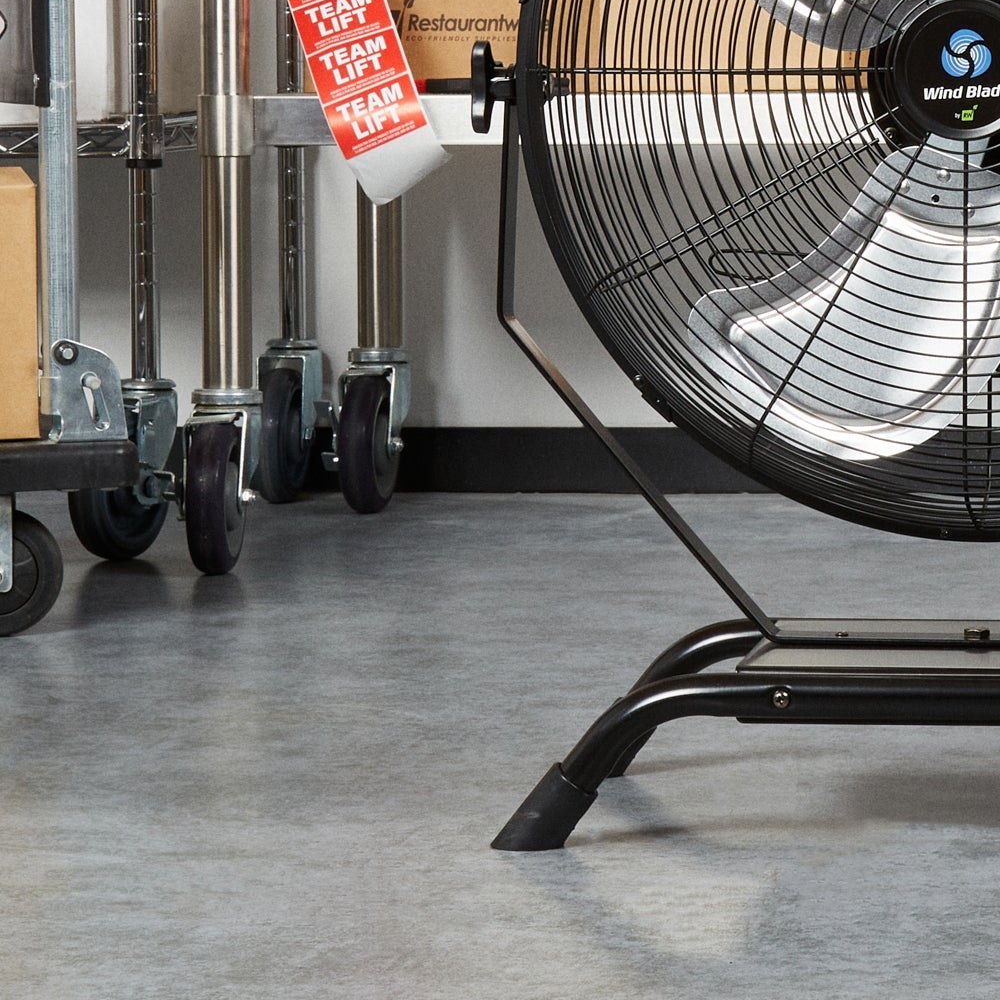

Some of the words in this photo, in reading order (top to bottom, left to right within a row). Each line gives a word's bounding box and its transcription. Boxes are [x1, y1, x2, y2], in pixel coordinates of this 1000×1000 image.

[317, 6, 367, 37] LIFT
[318, 35, 387, 71] TEAM
[332, 52, 382, 86] LIFT
[336, 82, 404, 122] TEAM
[923, 86, 963, 100] Wind
[351, 103, 401, 141] LIFT
